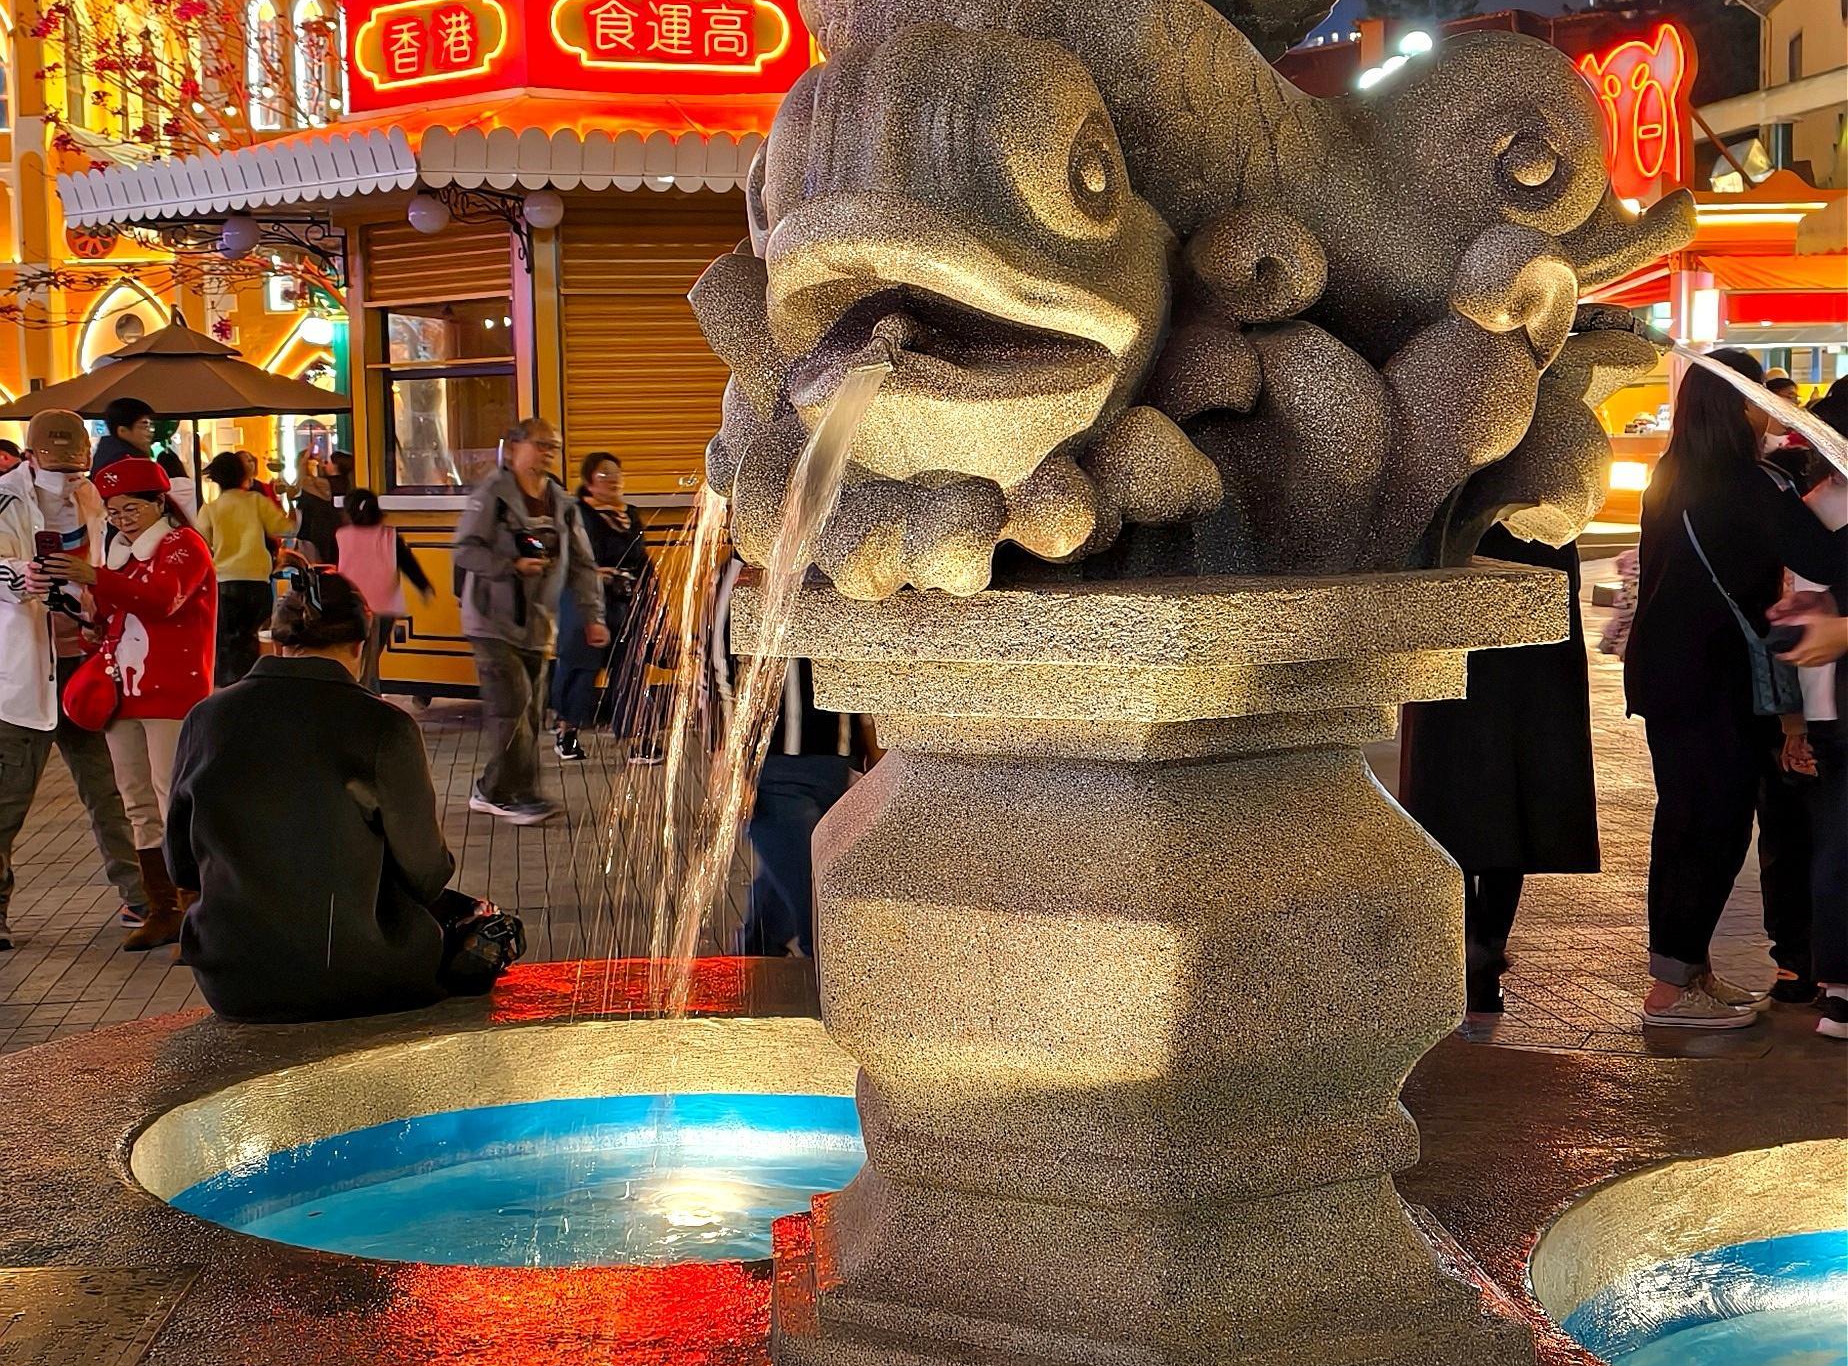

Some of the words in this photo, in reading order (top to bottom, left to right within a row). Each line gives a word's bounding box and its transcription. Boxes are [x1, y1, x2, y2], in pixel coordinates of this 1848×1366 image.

[389, 10, 473, 74] 香港
[588, 0, 749, 58] 食運高
